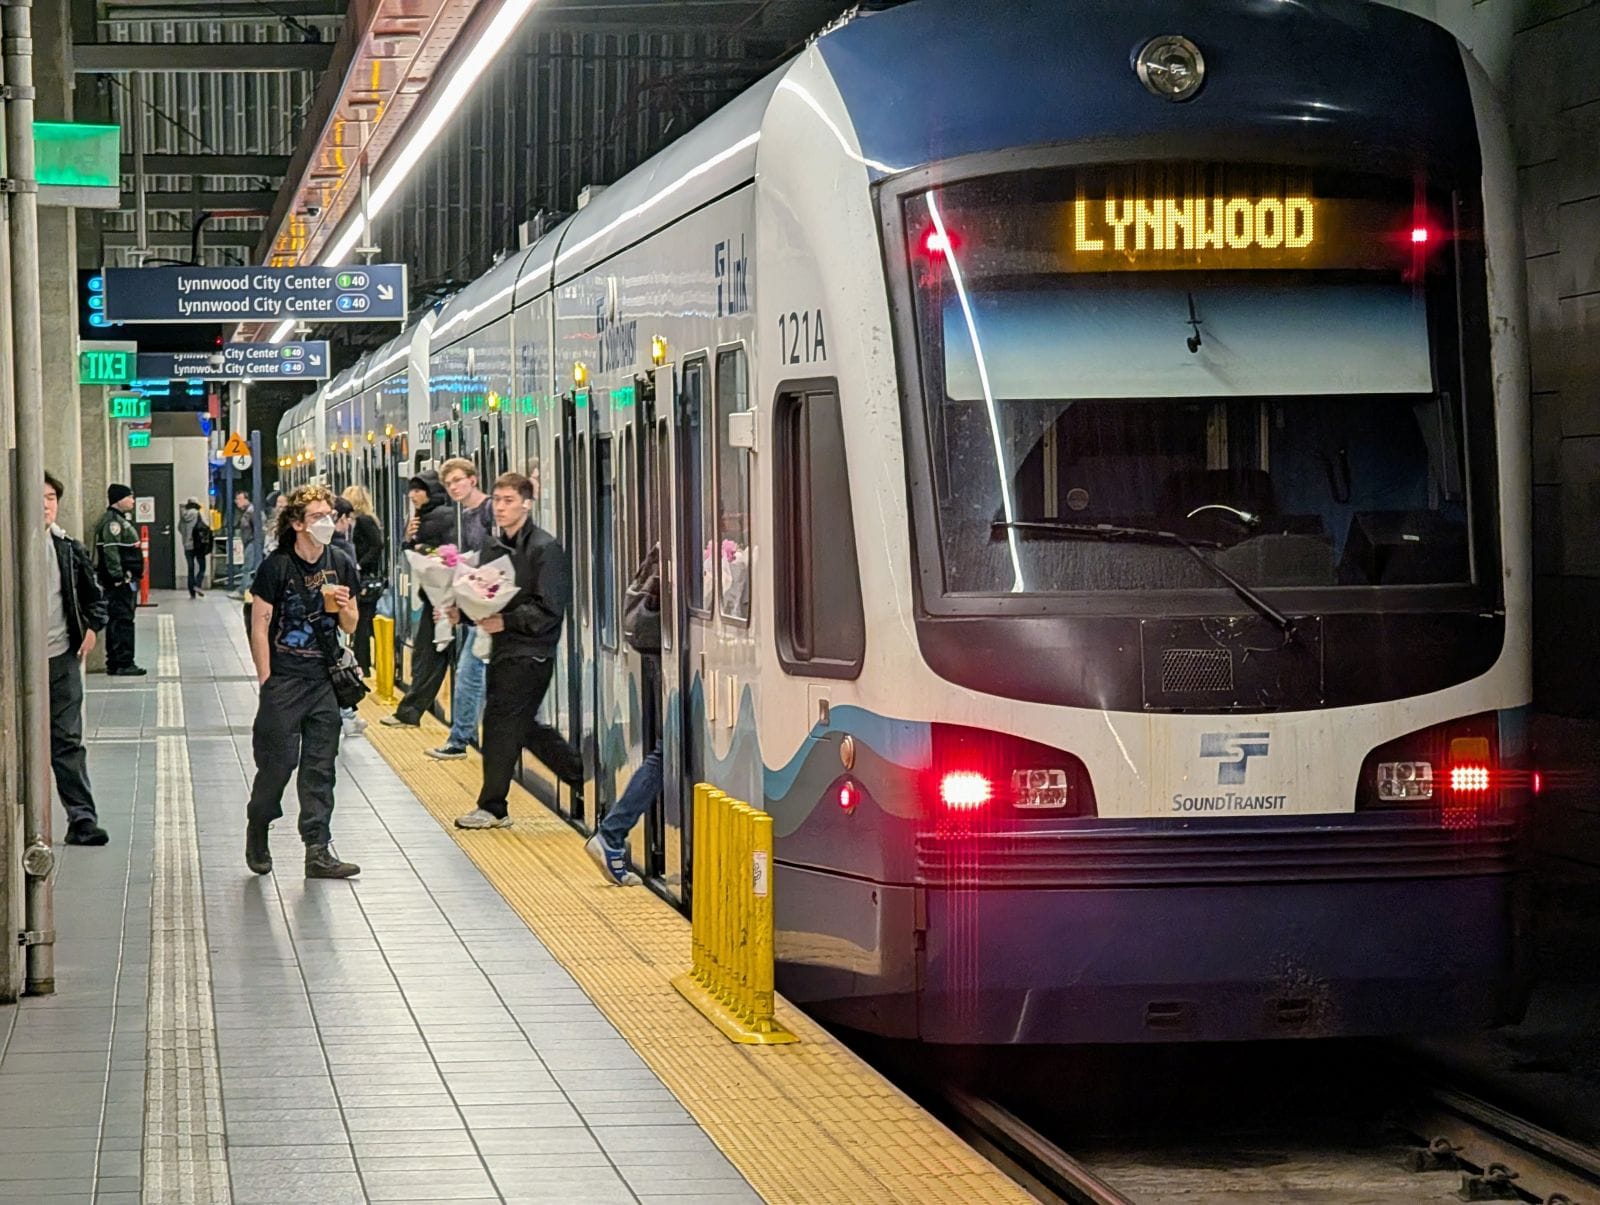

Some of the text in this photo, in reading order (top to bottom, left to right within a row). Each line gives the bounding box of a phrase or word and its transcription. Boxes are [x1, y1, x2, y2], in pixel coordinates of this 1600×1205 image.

[1075, 197, 1313, 250] LYNNWOOD
[728, 233, 748, 315] Link
[178, 276, 249, 294] Lynnwood
[253, 275, 280, 293] City
[285, 275, 332, 290] Center
[352, 276, 365, 286] 40
[178, 297, 249, 316] Lynnwood
[253, 297, 280, 315] City
[285, 296, 332, 312] Center
[352, 298, 365, 308] 40
[779, 309, 827, 365] 121A
[225, 348, 244, 361] City
[246, 348, 278, 359] Center
[225, 363, 244, 375] City
[246, 363, 279, 373] Center
[114, 398, 139, 417] EXIT
[232, 439, 240, 453] 2
[238, 455, 245, 466] 4
